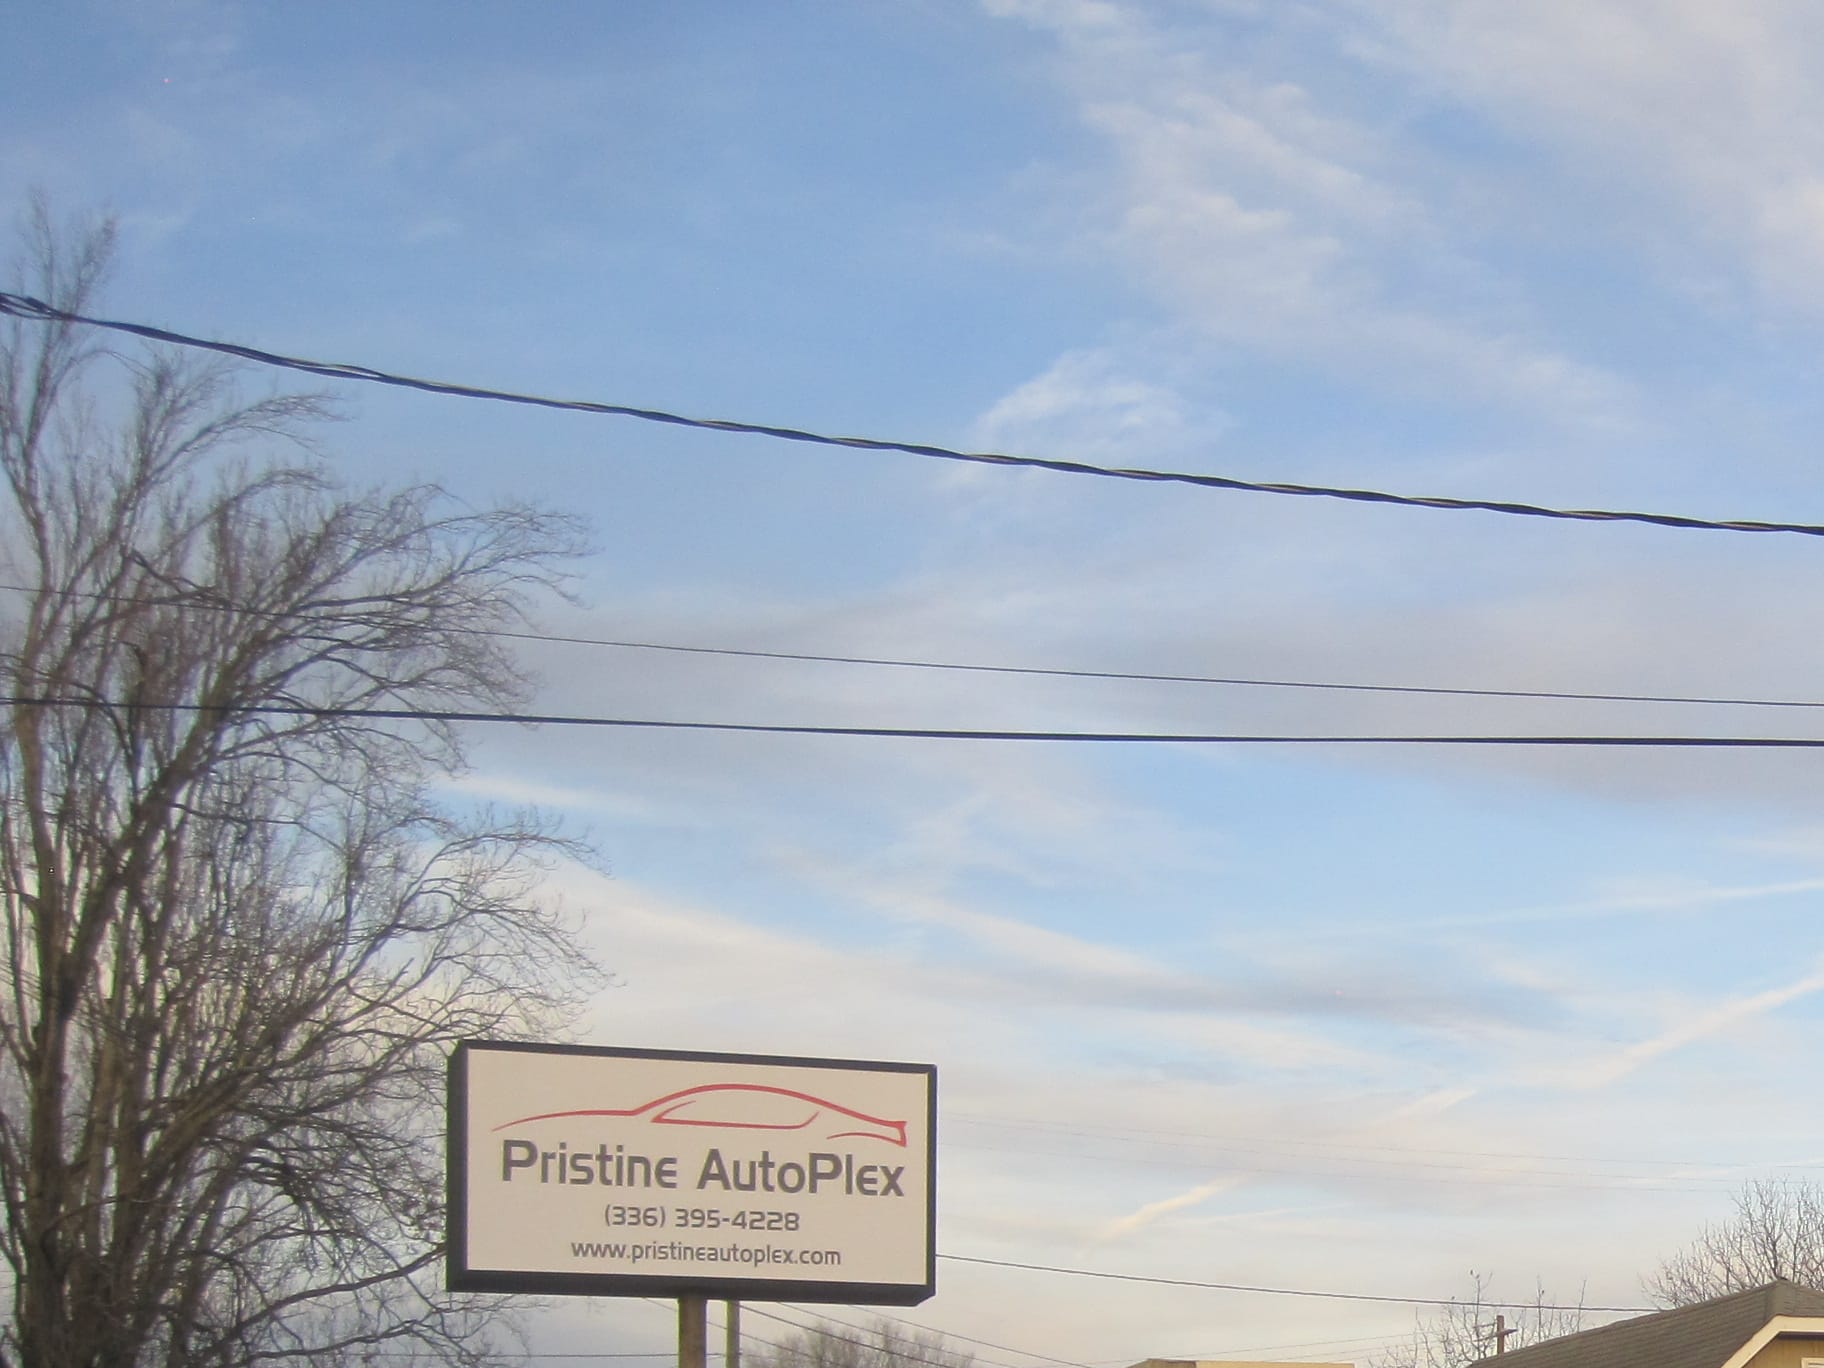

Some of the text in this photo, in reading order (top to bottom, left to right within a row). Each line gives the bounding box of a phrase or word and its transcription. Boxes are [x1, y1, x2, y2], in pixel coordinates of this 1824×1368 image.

[502, 1139, 904, 1196] Pristine AutoPlex
[604, 1204, 800, 1231] (336) 395-4228
[571, 1241, 841, 1267] www.pristineautoplex.com
